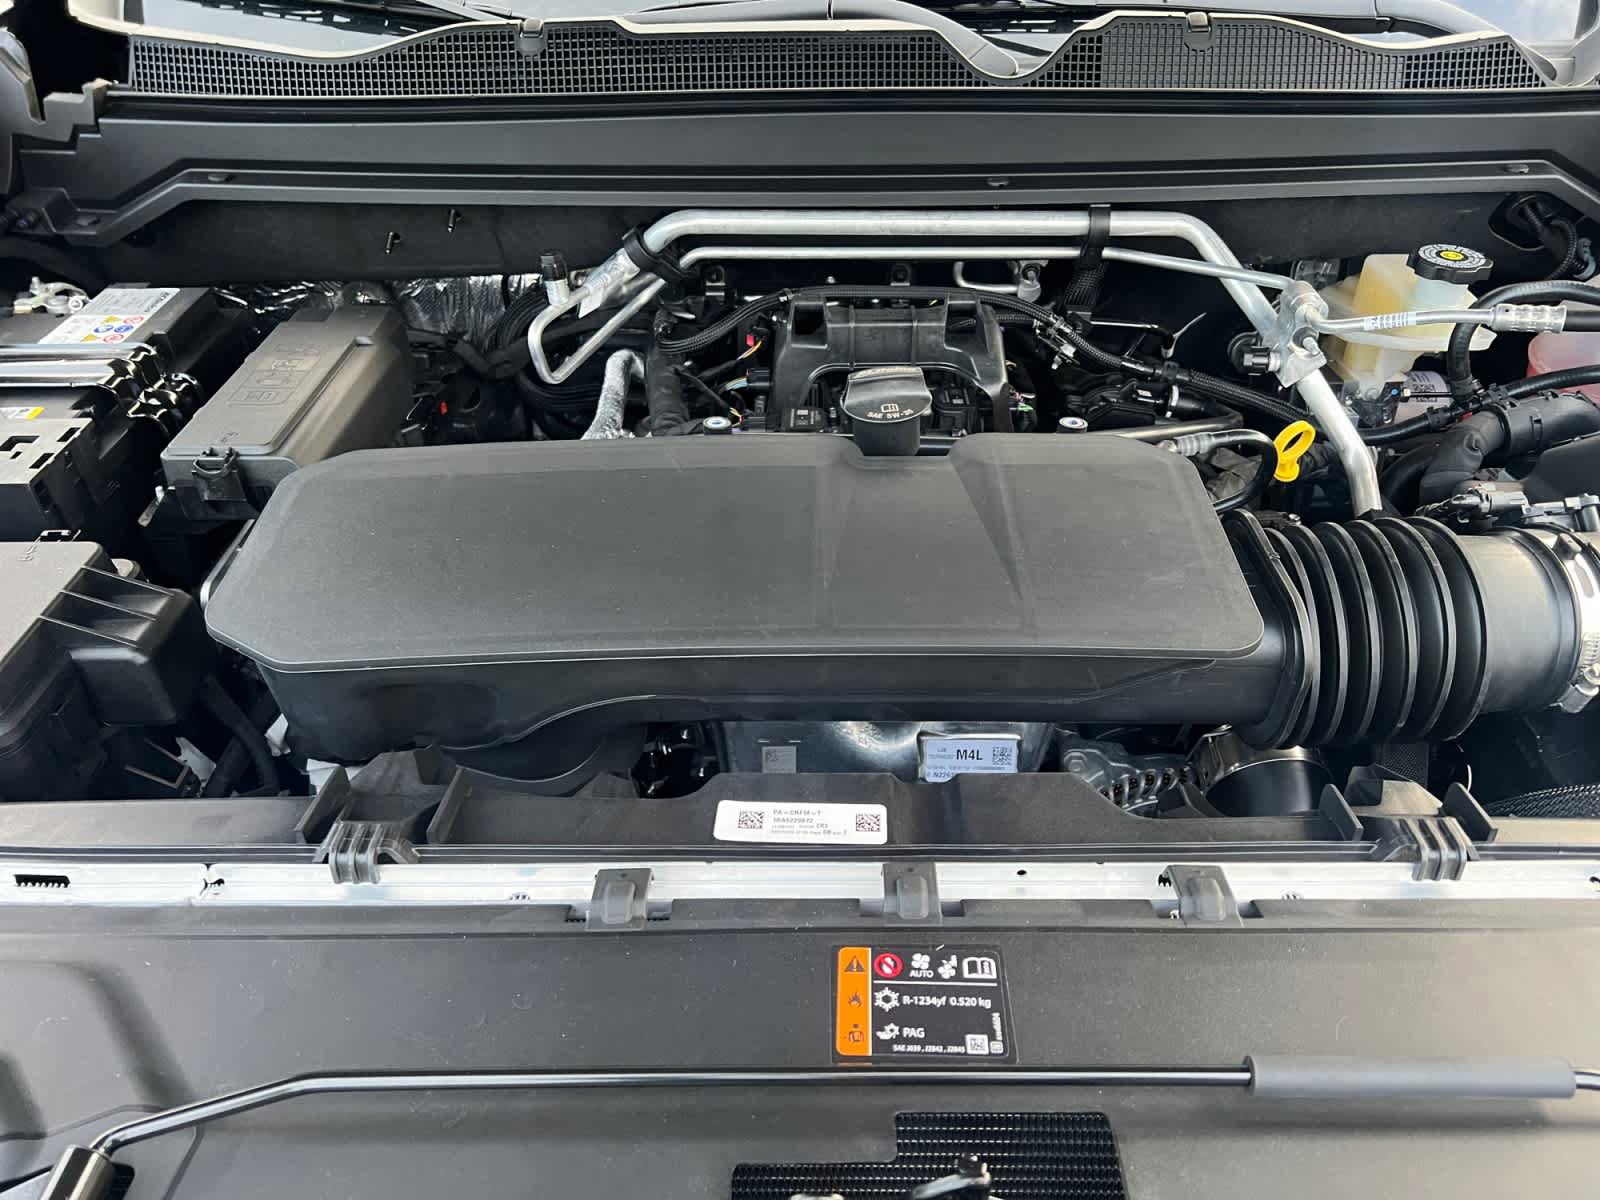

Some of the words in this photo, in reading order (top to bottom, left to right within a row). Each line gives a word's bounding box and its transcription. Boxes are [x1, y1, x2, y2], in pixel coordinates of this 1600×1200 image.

[956, 749, 984, 761] M4L
[909, 970, 934, 978] AUTO
[902, 995, 947, 1009] R-1234yf
[949, 996, 977, 1008] 0.520
[979, 996, 992, 1009] kg
[903, 1027, 926, 1039] PAG
